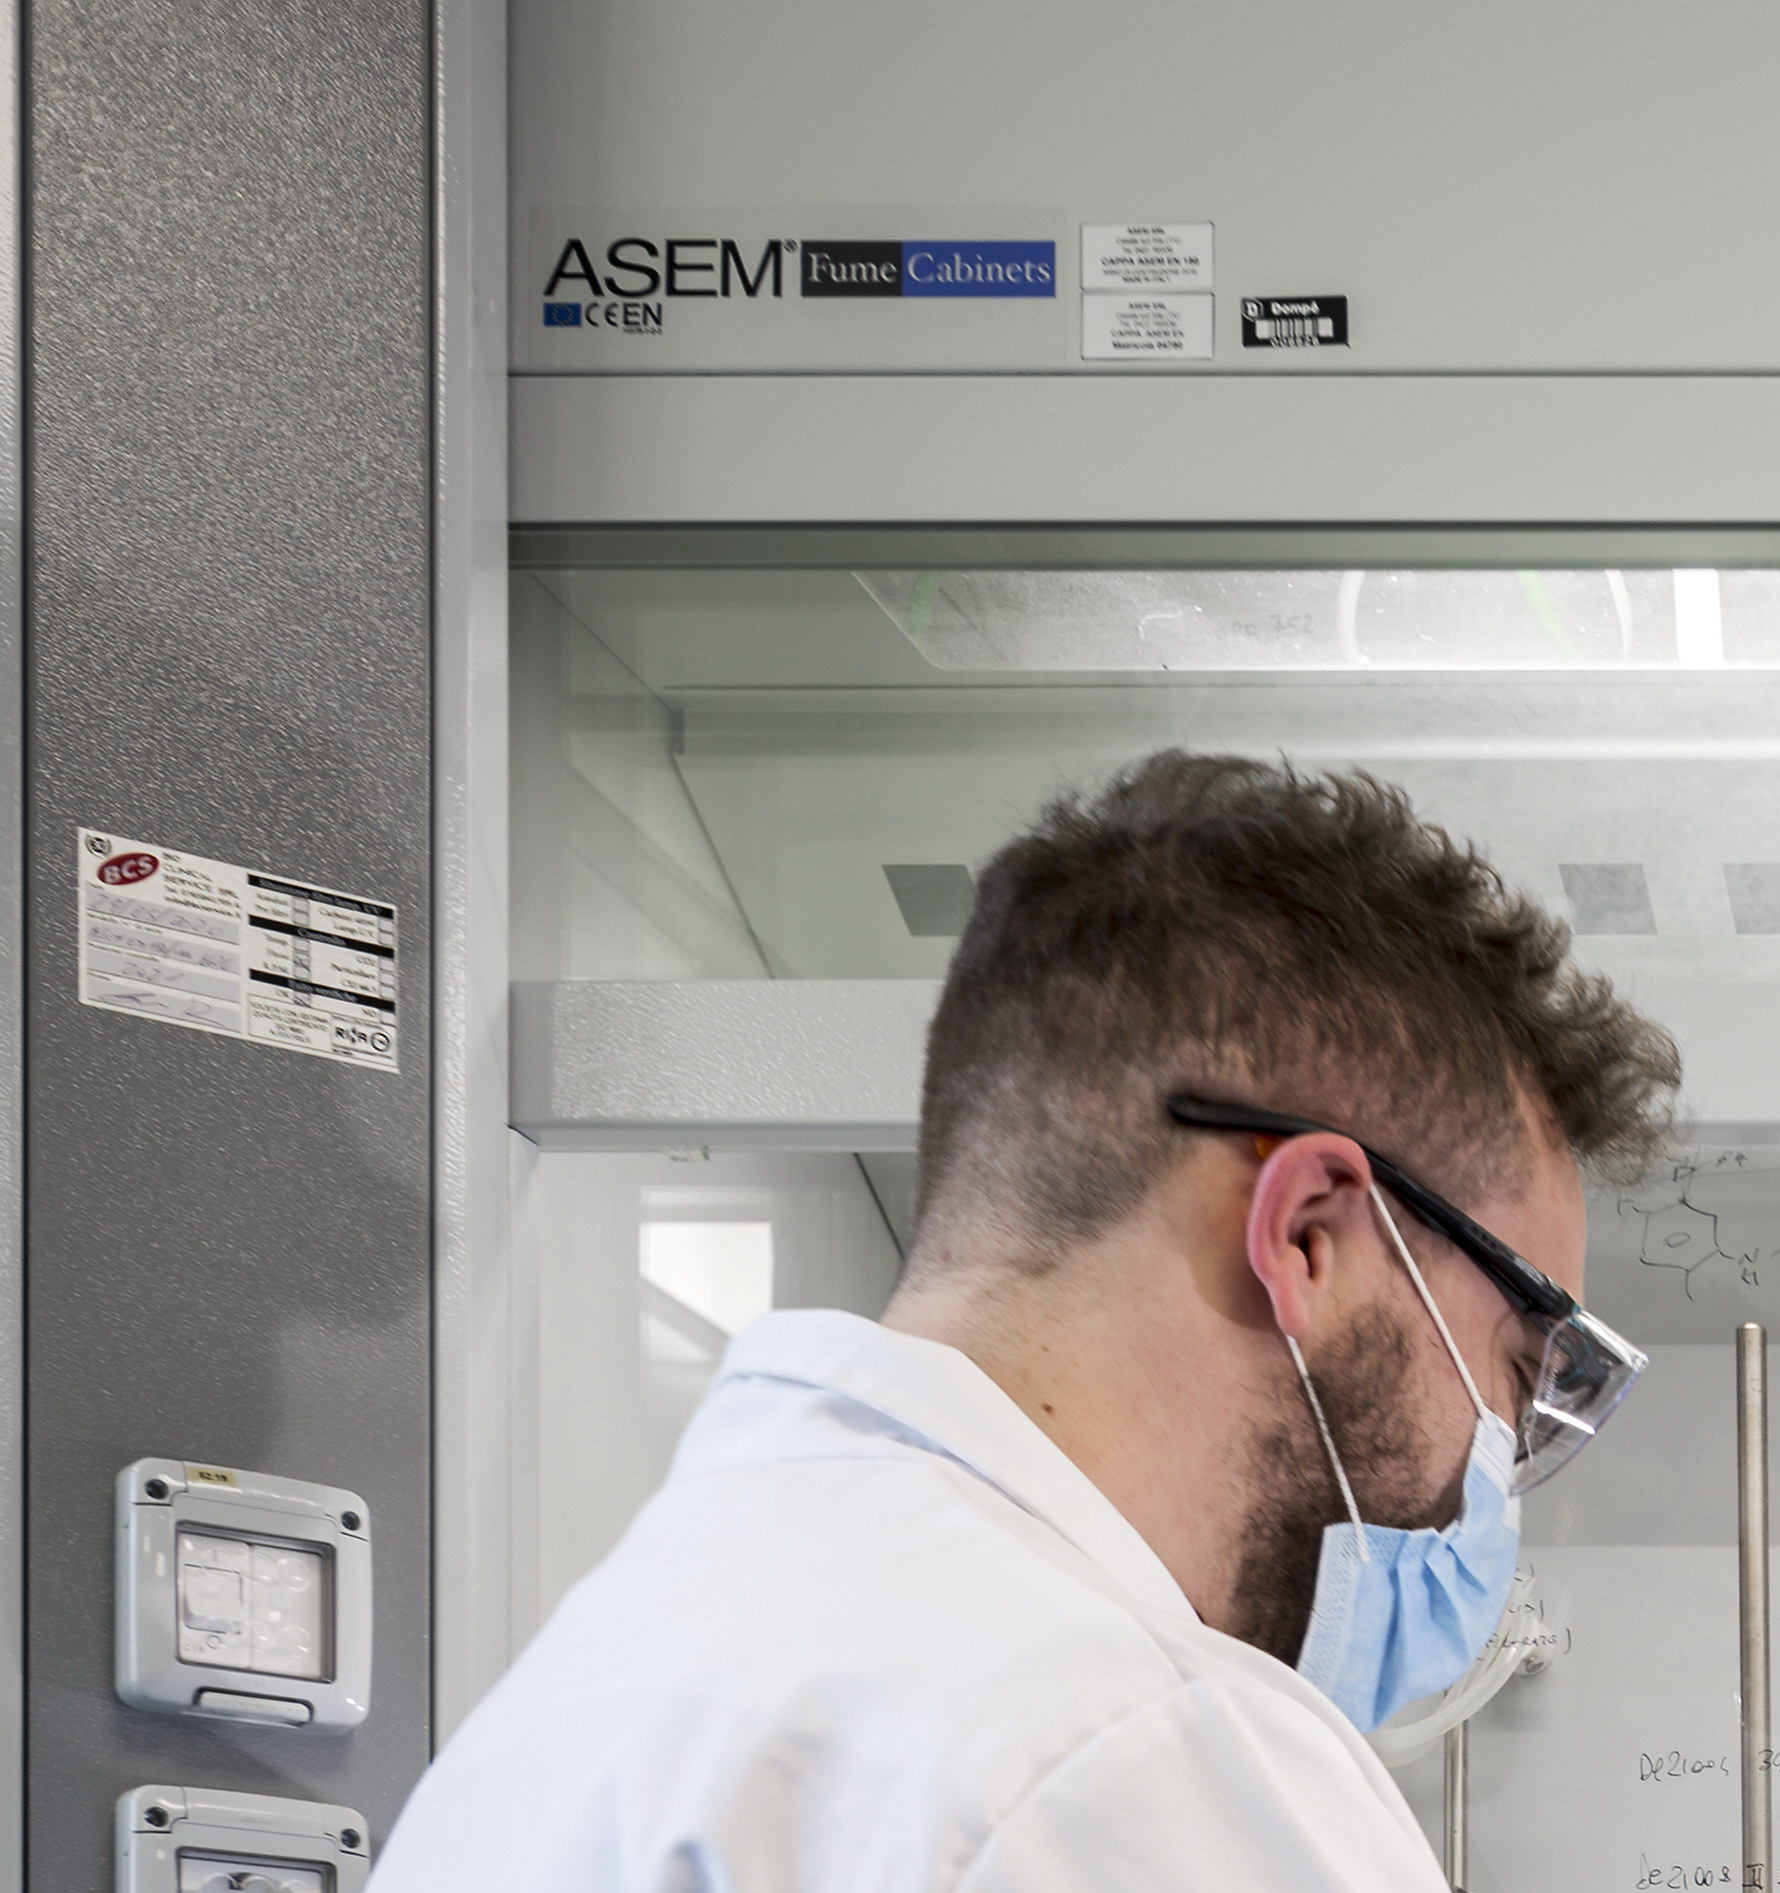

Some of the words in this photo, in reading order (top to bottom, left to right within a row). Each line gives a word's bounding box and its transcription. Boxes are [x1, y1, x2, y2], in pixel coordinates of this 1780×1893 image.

[809, 252, 897, 283] Fume
[908, 251, 1051, 284] Cabinets
[624, 302, 663, 326] EN
[103, 855, 155, 883] BCS
